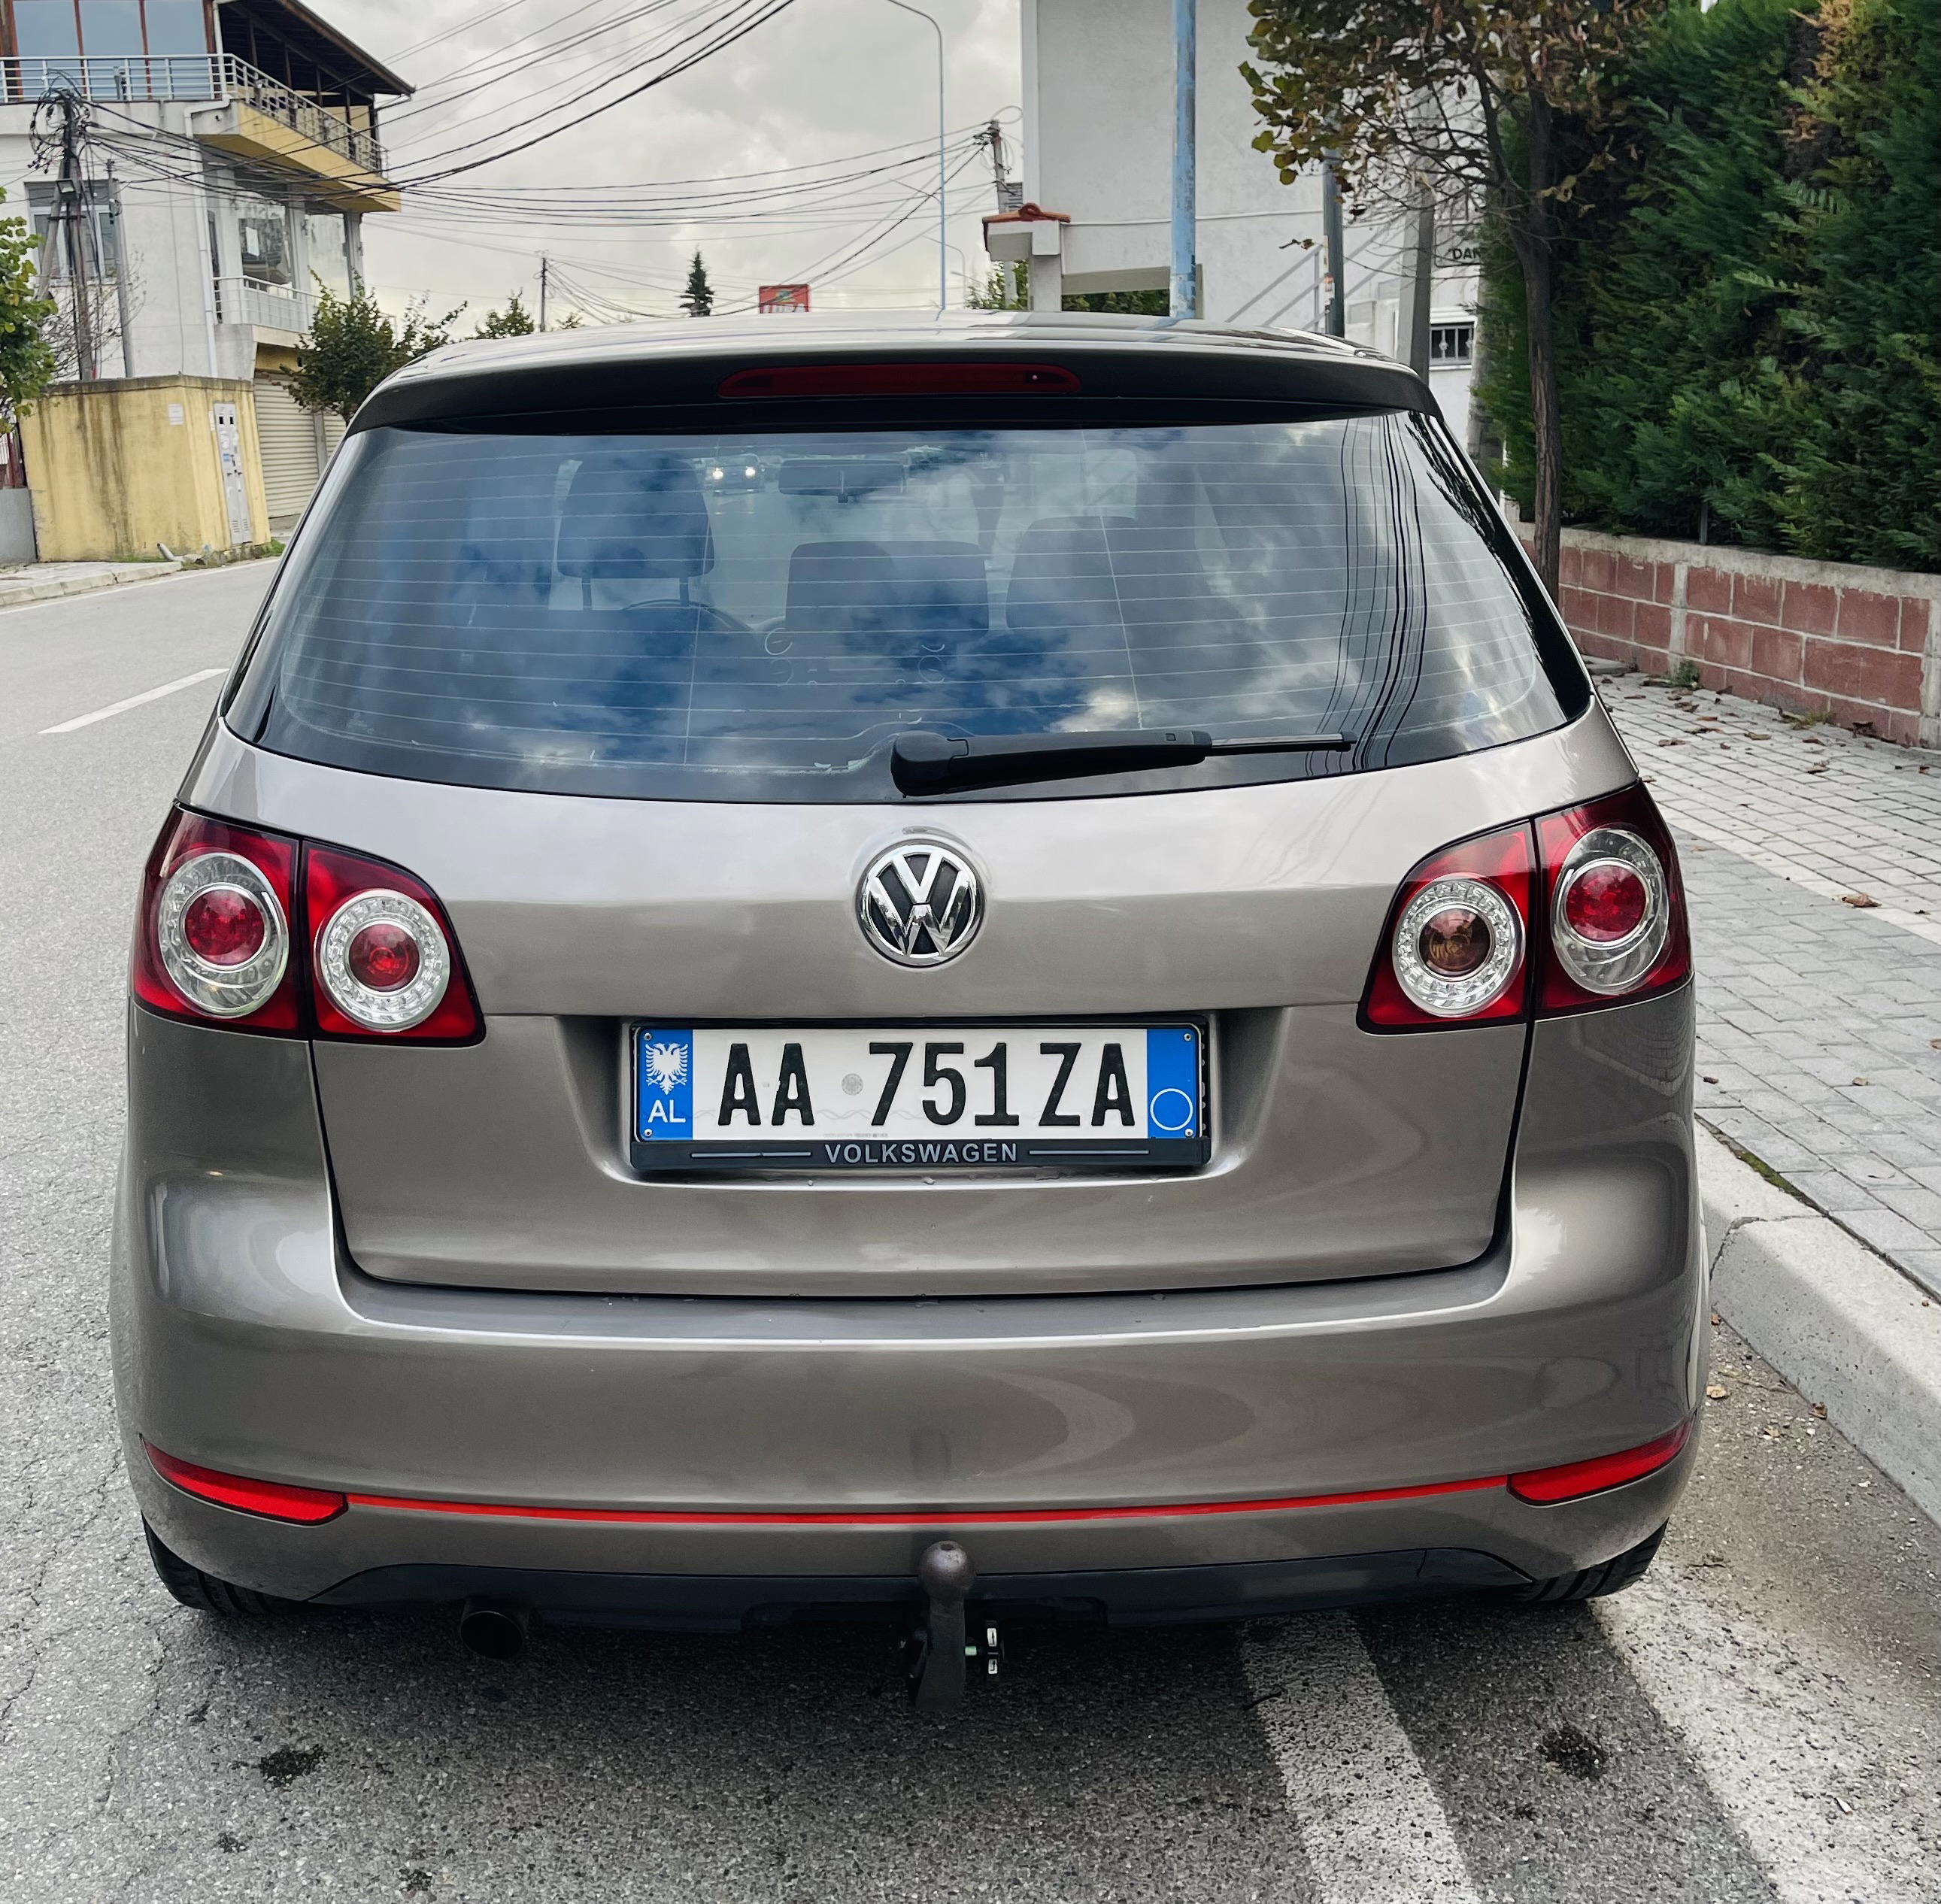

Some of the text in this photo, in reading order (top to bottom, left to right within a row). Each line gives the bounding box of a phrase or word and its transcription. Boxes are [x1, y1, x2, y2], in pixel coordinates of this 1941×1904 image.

[717, 1042, 815, 1126] AA
[648, 1099, 687, 1123] AL
[824, 1142, 1018, 1164] VOLKSWAGEN
